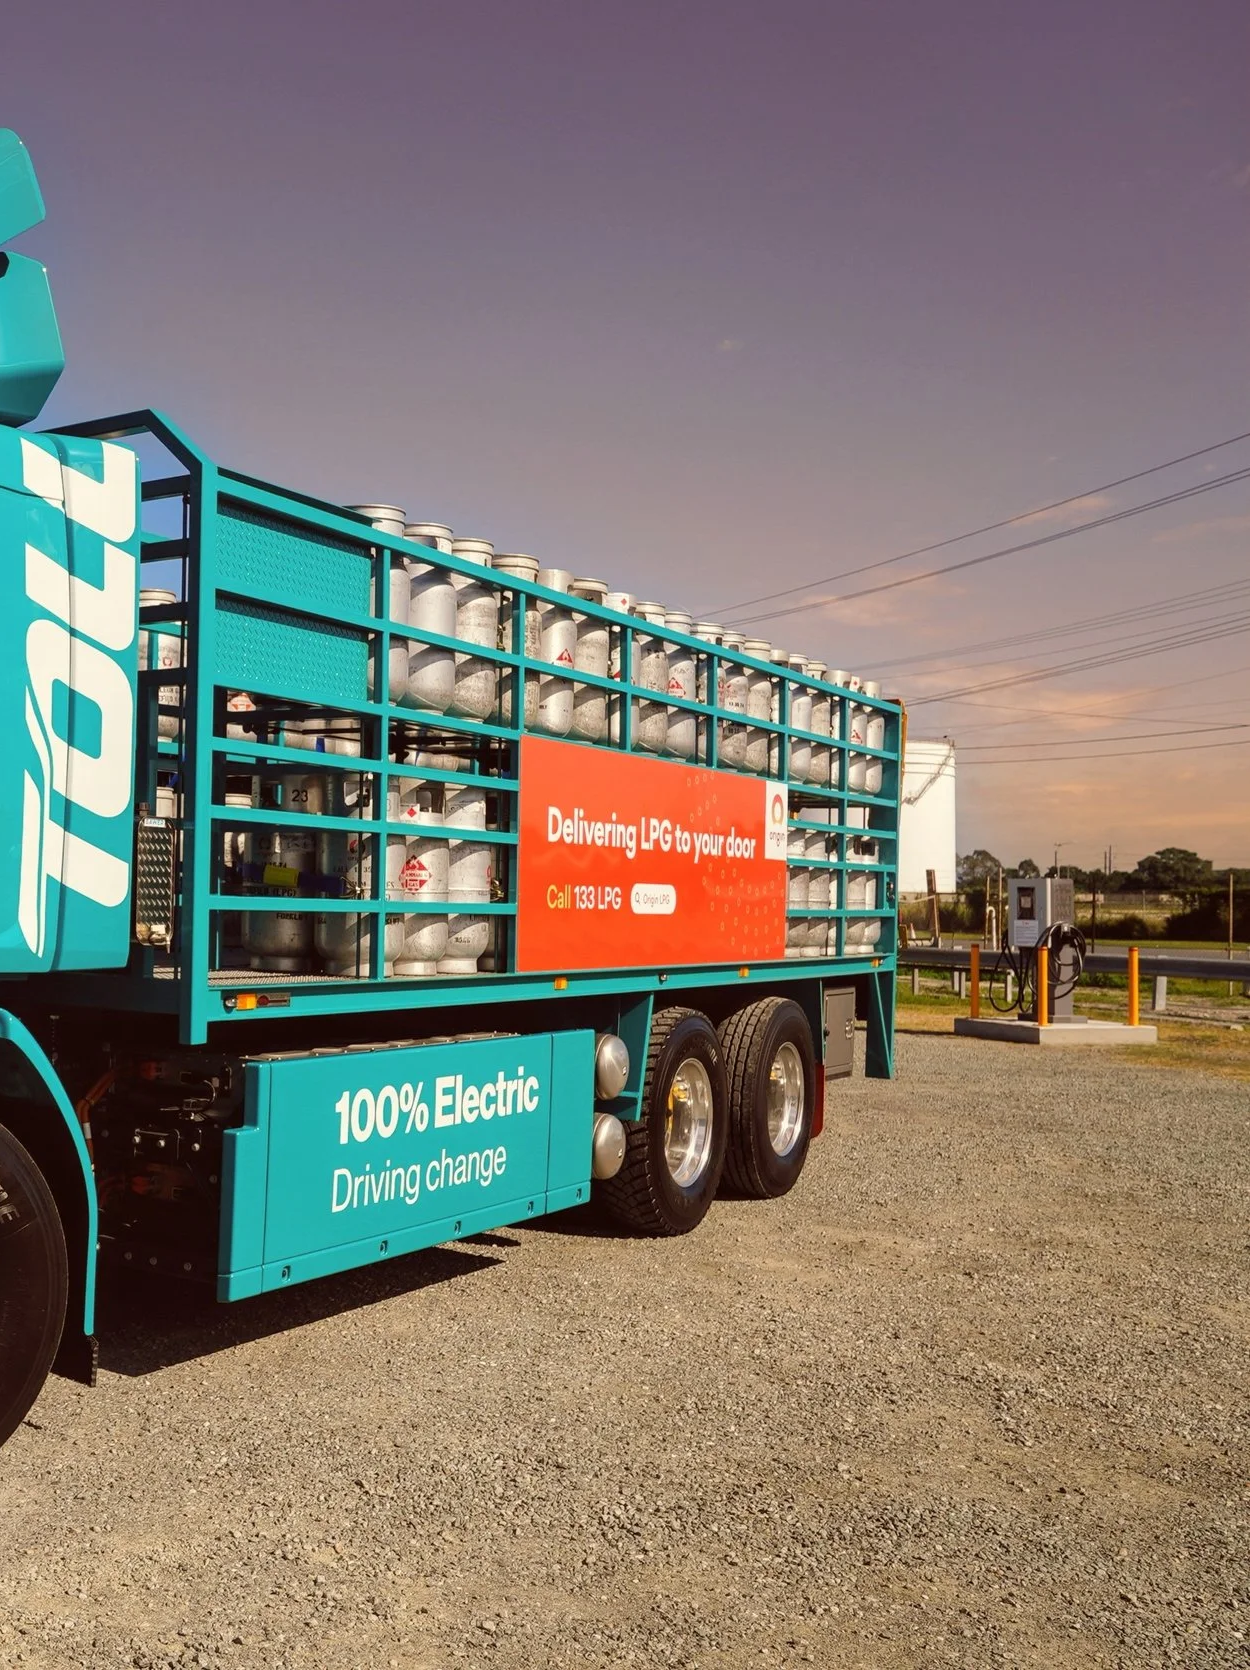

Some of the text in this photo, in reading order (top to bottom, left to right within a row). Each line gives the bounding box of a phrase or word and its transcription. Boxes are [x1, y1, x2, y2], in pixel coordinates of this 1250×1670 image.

[18, 436, 138, 959] TOLL
[291, 789, 309, 803] 23
[547, 806, 757, 864] Delivering LPG to your door
[546, 885, 622, 910] Call 133 LPG
[643, 893, 670, 908] Origin LPG
[335, 1065, 540, 1145] 100% Electric
[331, 1145, 507, 1213] Driving change
